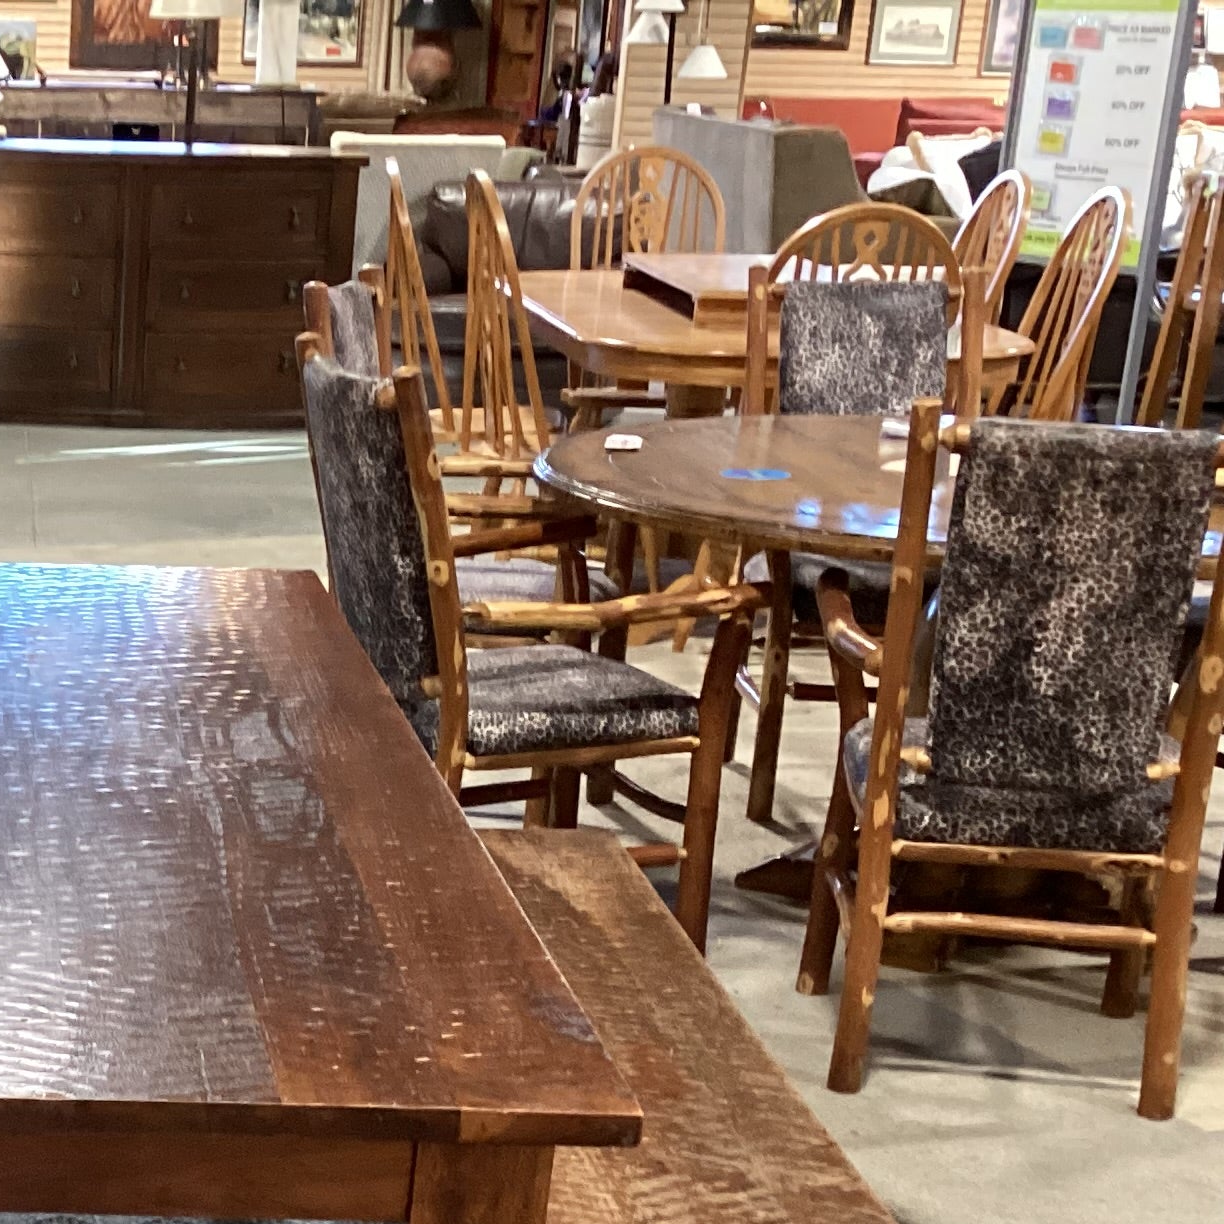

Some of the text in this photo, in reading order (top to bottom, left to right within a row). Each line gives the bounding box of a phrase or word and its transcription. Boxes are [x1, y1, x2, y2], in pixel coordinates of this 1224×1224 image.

[1134, 65, 1151, 74] OFF
[1128, 101, 1145, 110] OFF
[1123, 138, 1140, 147] OFF
